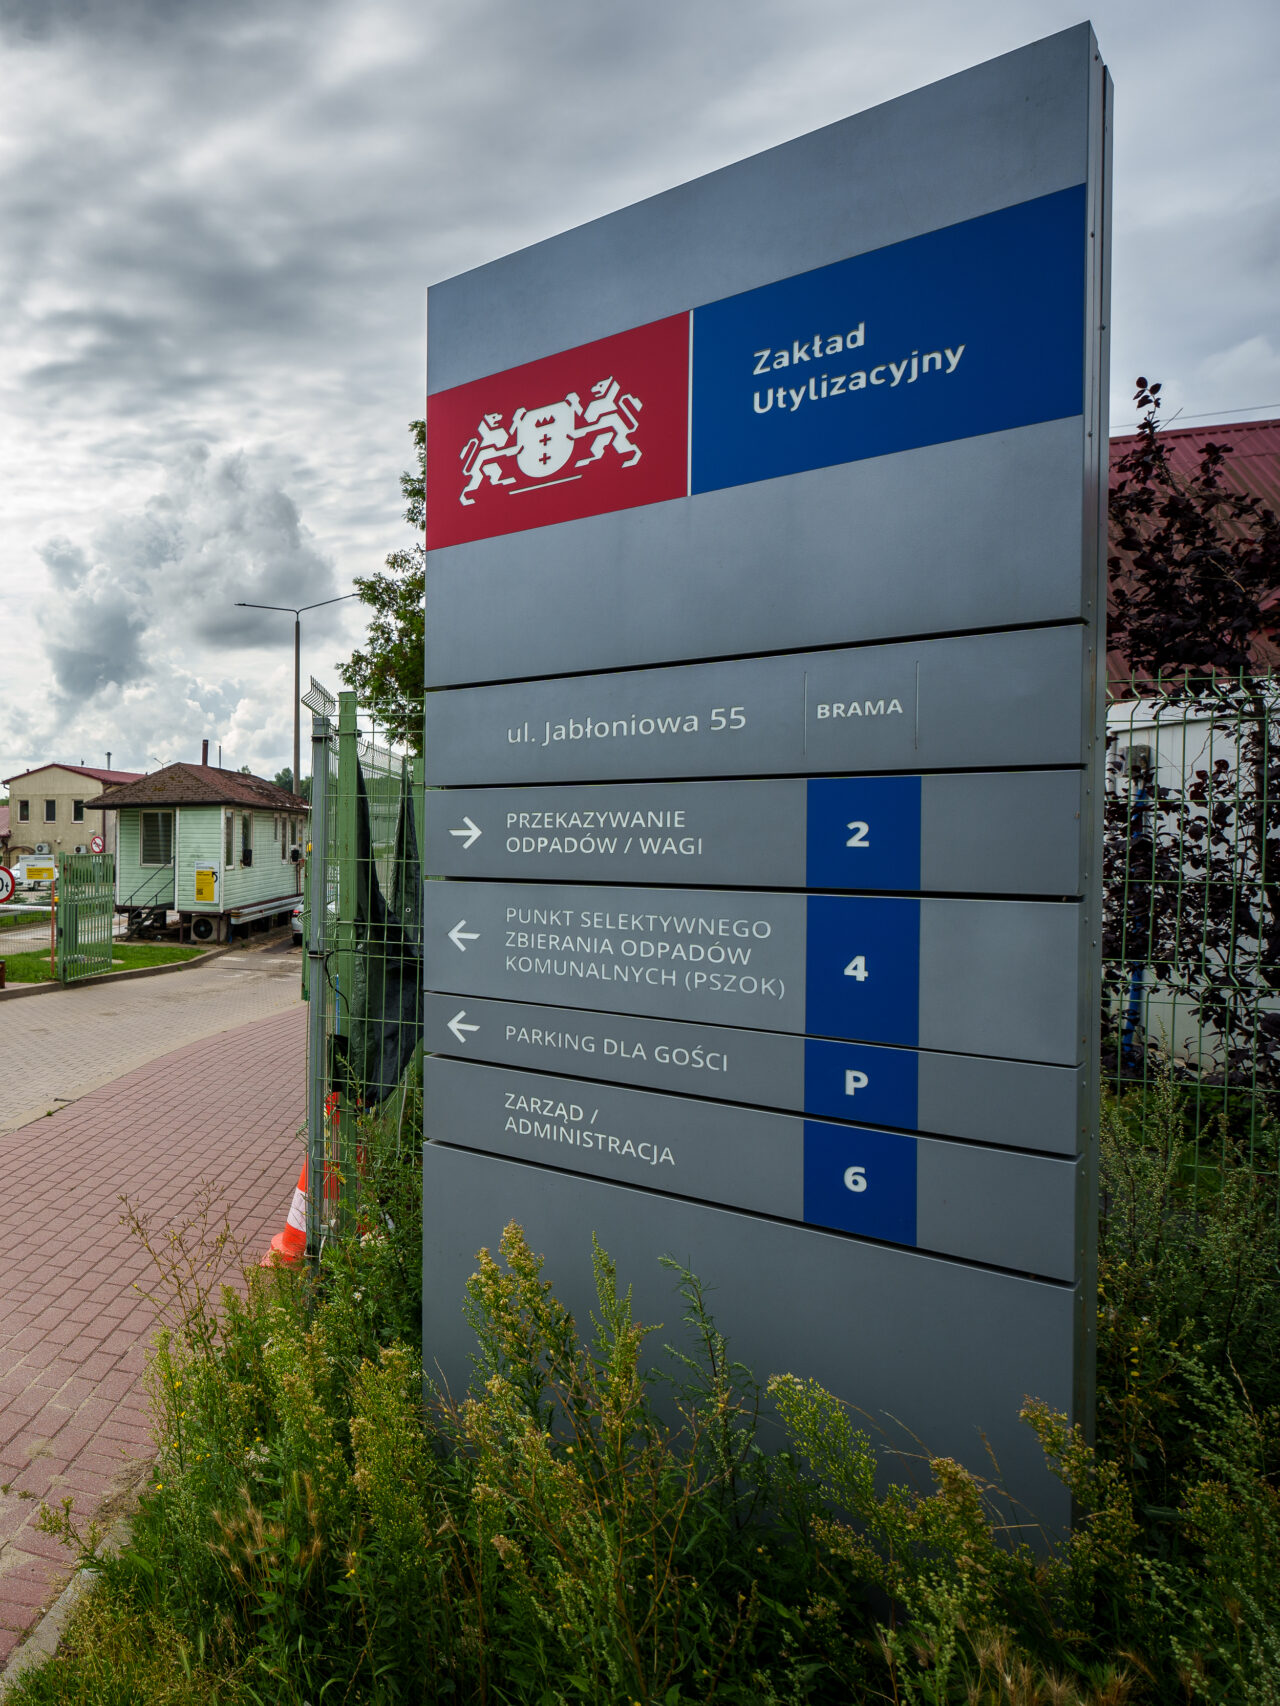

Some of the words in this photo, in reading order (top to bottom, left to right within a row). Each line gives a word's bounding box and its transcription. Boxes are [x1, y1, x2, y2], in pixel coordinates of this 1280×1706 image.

[753, 321, 866, 376] Zakład
[753, 344, 966, 414] Utylizacyjny
[817, 699, 903, 719] BRAMA
[507, 722, 536, 744] ul.
[542, 715, 699, 747] Jabłoniowa
[710, 707, 747, 731] 55
[506, 810, 686, 829] PRZEKAZYWANIE
[846, 821, 870, 848] 2
[506, 832, 618, 854] ODPADÓW
[623, 837, 633, 855] /
[639, 837, 702, 855] WAGI
[506, 907, 574, 926] PUNKT
[580, 911, 771, 939] SELEKTYWNEGO
[505, 931, 614, 955] ZBIERANIA
[620, 937, 752, 966] ODPADÓW
[506, 956, 676, 986] KOMUNALNYCH
[685, 971, 786, 999] (PSZOK)
[843, 955, 869, 982] 4
[506, 1025, 595, 1053] PARKING
[603, 1038, 647, 1061] DLA
[654, 1044, 728, 1072] GOŚCI
[845, 1069, 869, 1096] P
[504, 1092, 584, 1124] ZARZĄD
[590, 1109, 599, 1124] /
[504, 1116, 675, 1166] ADMINISTRACJA
[844, 1166, 867, 1193] 6
